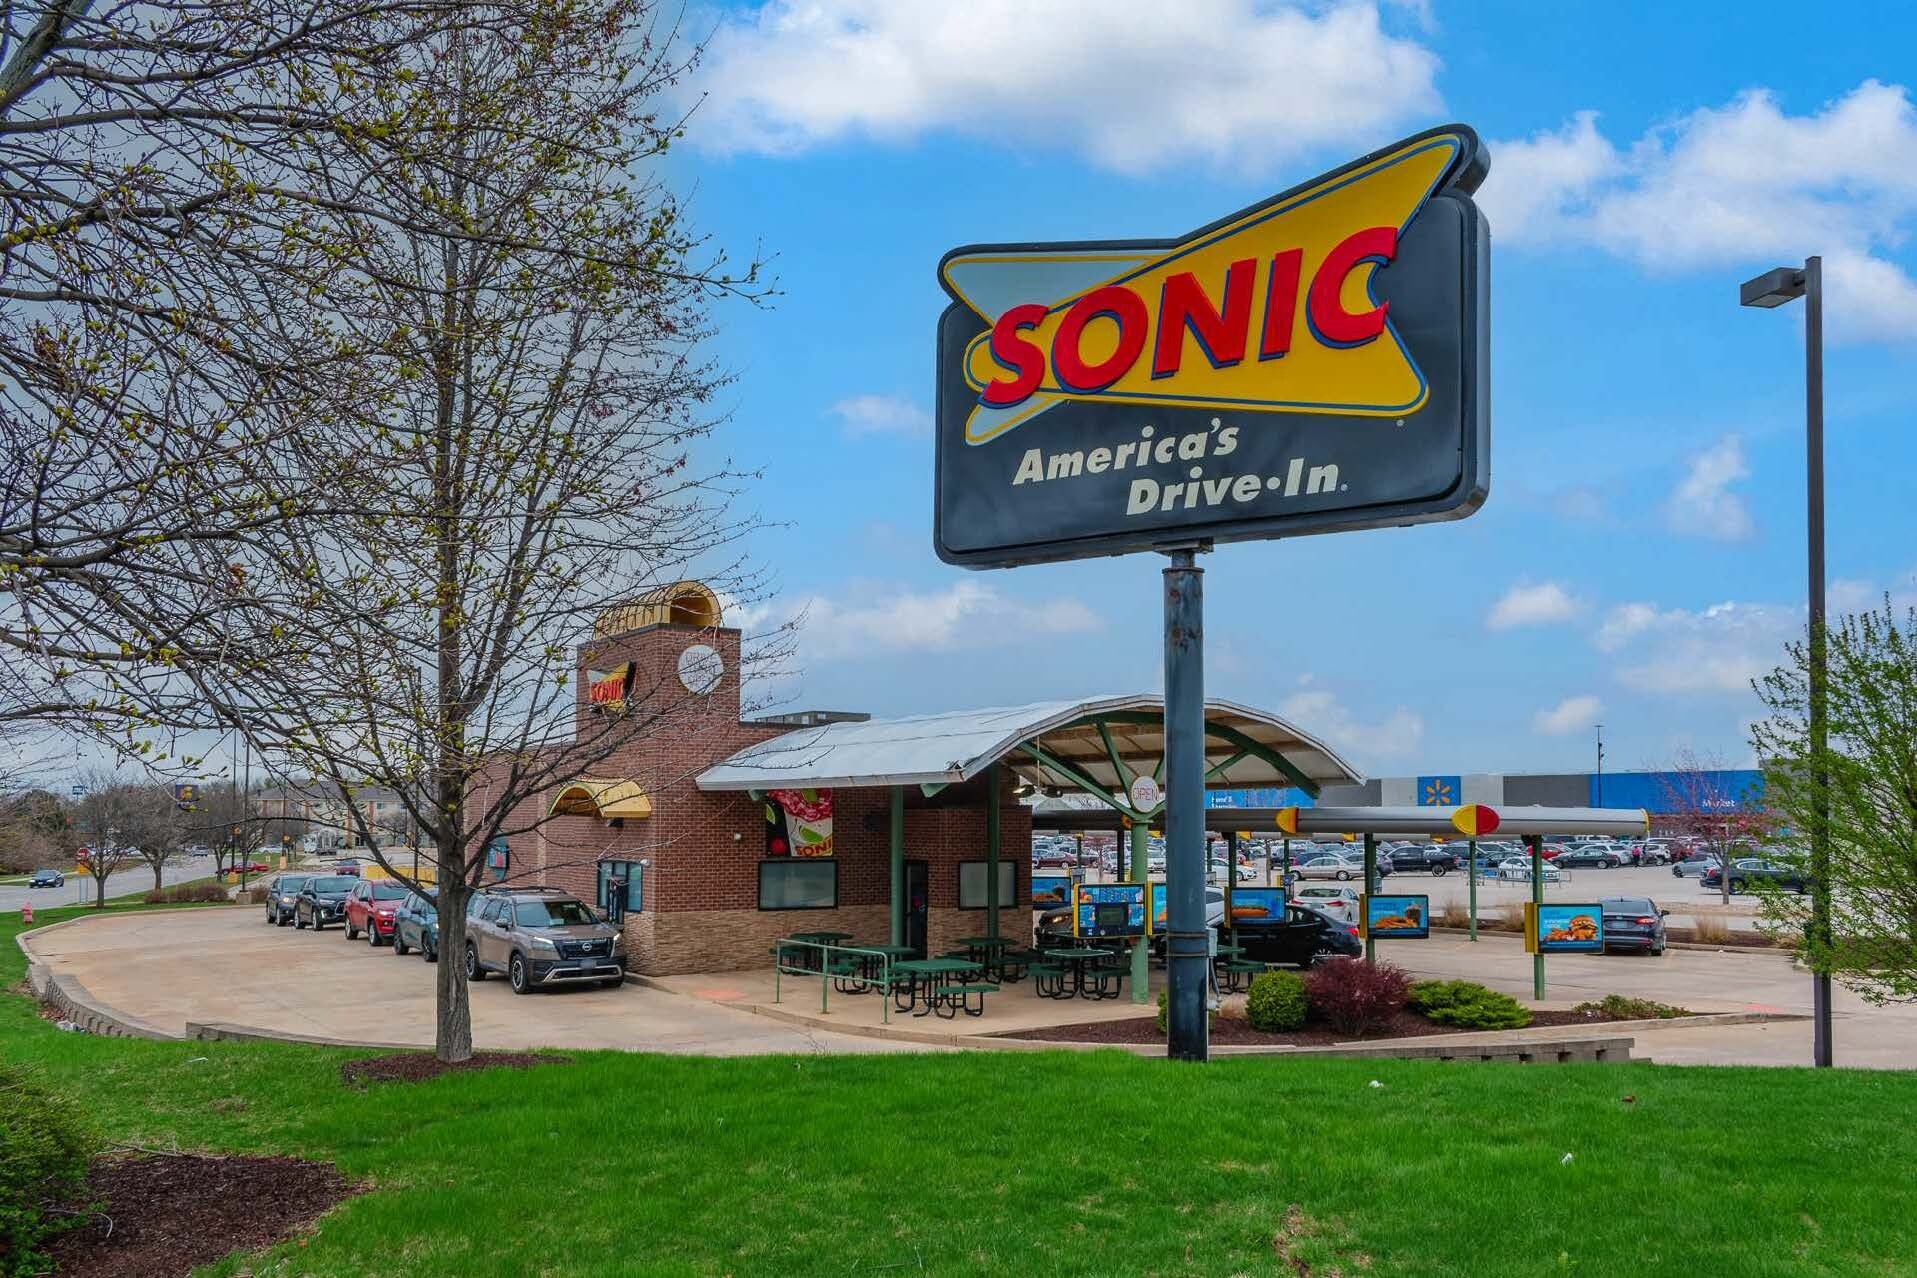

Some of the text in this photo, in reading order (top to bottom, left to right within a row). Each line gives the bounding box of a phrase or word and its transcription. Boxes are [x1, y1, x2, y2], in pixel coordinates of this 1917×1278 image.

[979, 227, 1398, 408] SONIC
[1012, 417, 1240, 485] America's
[1132, 786, 1159, 801] OPEN
